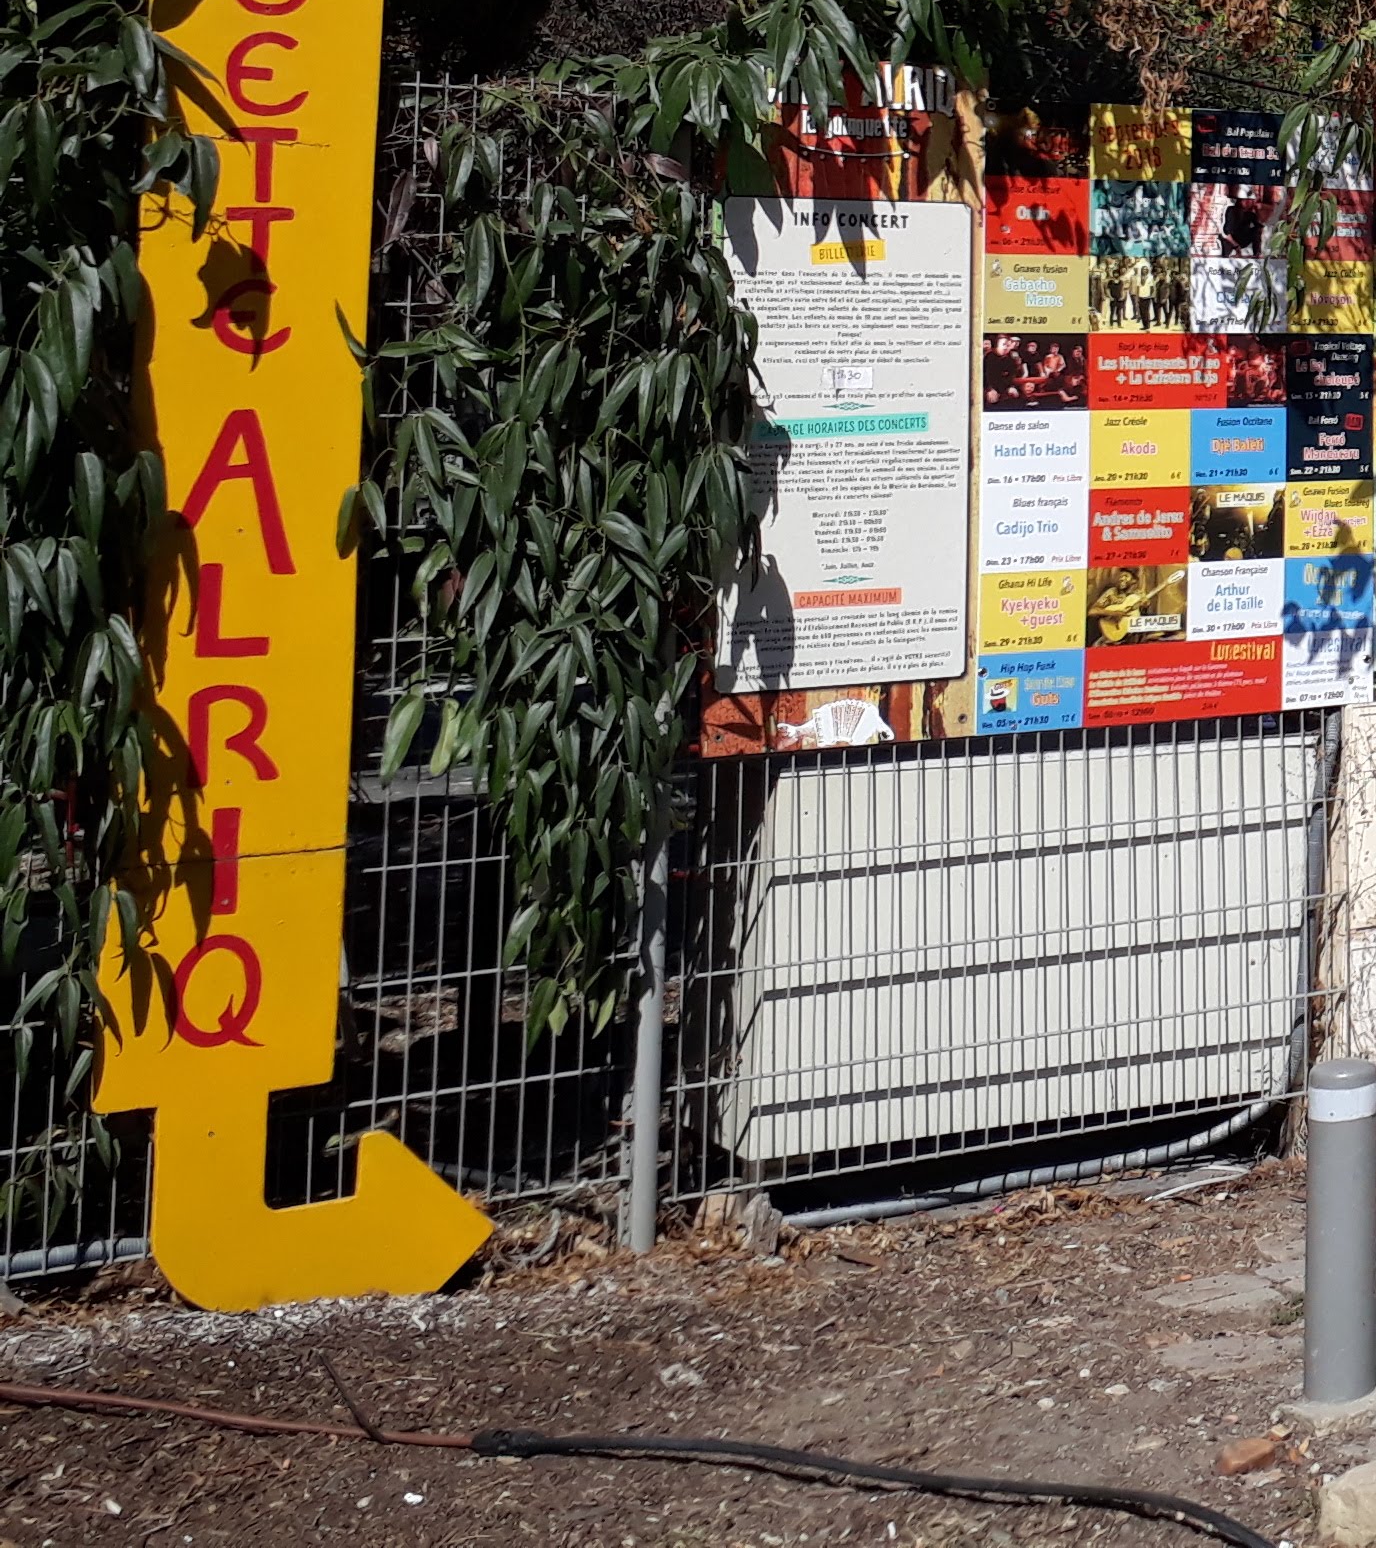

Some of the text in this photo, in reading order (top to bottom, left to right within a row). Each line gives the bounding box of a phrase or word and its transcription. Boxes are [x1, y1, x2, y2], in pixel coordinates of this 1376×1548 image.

[1226, 126, 1273, 139] Bal Populaire
[1222, 143, 1238, 158] du
[794, 213, 910, 229] INFO CONCERT
[1043, 264, 1068, 273] fusion
[1003, 276, 1057, 293] Gabacho
[1025, 293, 1064, 307] Maroc
[1022, 316, 1048, 325] 21h30
[1098, 356, 1118, 370] Les
[1119, 355, 1187, 370] Hurlements
[1296, 358, 1326, 372] Le Bal
[1128, 371, 1143, 385] La
[1313, 371, 1361, 389] chaloupé
[1320, 391, 1341, 400] 21h30
[807, 416, 928, 435] HORAIRES DES CONCERTS
[988, 420, 1050, 431] Danse de salon
[1104, 416, 1147, 426] Jazz Créole
[1217, 416, 1273, 426] Fusion Occitane
[994, 442, 1077, 457] Hand To Hand
[1121, 442, 1157, 454] Akoda
[1209, 469, 1248, 477] 21 21h30
[1318, 465, 1340, 474] 21h30
[1003, 473, 1082, 483] 16 17h00 Prix Libre
[1107, 472, 1148, 481] 20 21h30
[1328, 486, 1350, 495] Fusion
[1012, 497, 1068, 509] Blues français
[1219, 493, 1265, 503] LE MAQUIS
[1324, 499, 1342, 507] Blues
[1136, 509, 1152, 525] de
[1300, 510, 1336, 522] Wijdan
[996, 520, 1058, 537] Cadijo Trio
[1102, 526, 1113, 541] &
[1001, 554, 1081, 565] 23 17h00 Prix Libre
[1201, 565, 1268, 577] Chanson Française
[998, 577, 1052, 589] Ghana Life
[1215, 583, 1250, 596] Arthur
[800, 591, 897, 607] CAPACITÉ MAXIMUM
[1001, 597, 1059, 614] Kyekyeku
[1207, 598, 1234, 612] de la
[1020, 612, 1064, 629] +guest
[1129, 615, 1178, 628] LE MAQUIS
[1206, 624, 1216, 633] 30
[1222, 622, 1245, 632] 17h00
[1263, 620, 1278, 628] Libre
[1000, 636, 1043, 646] 29 21h30
[1001, 660, 1056, 674] Hip Hop Funk
[1023, 715, 1049, 726] 21h30
[173, 407, 296, 1048] ALRIQ
